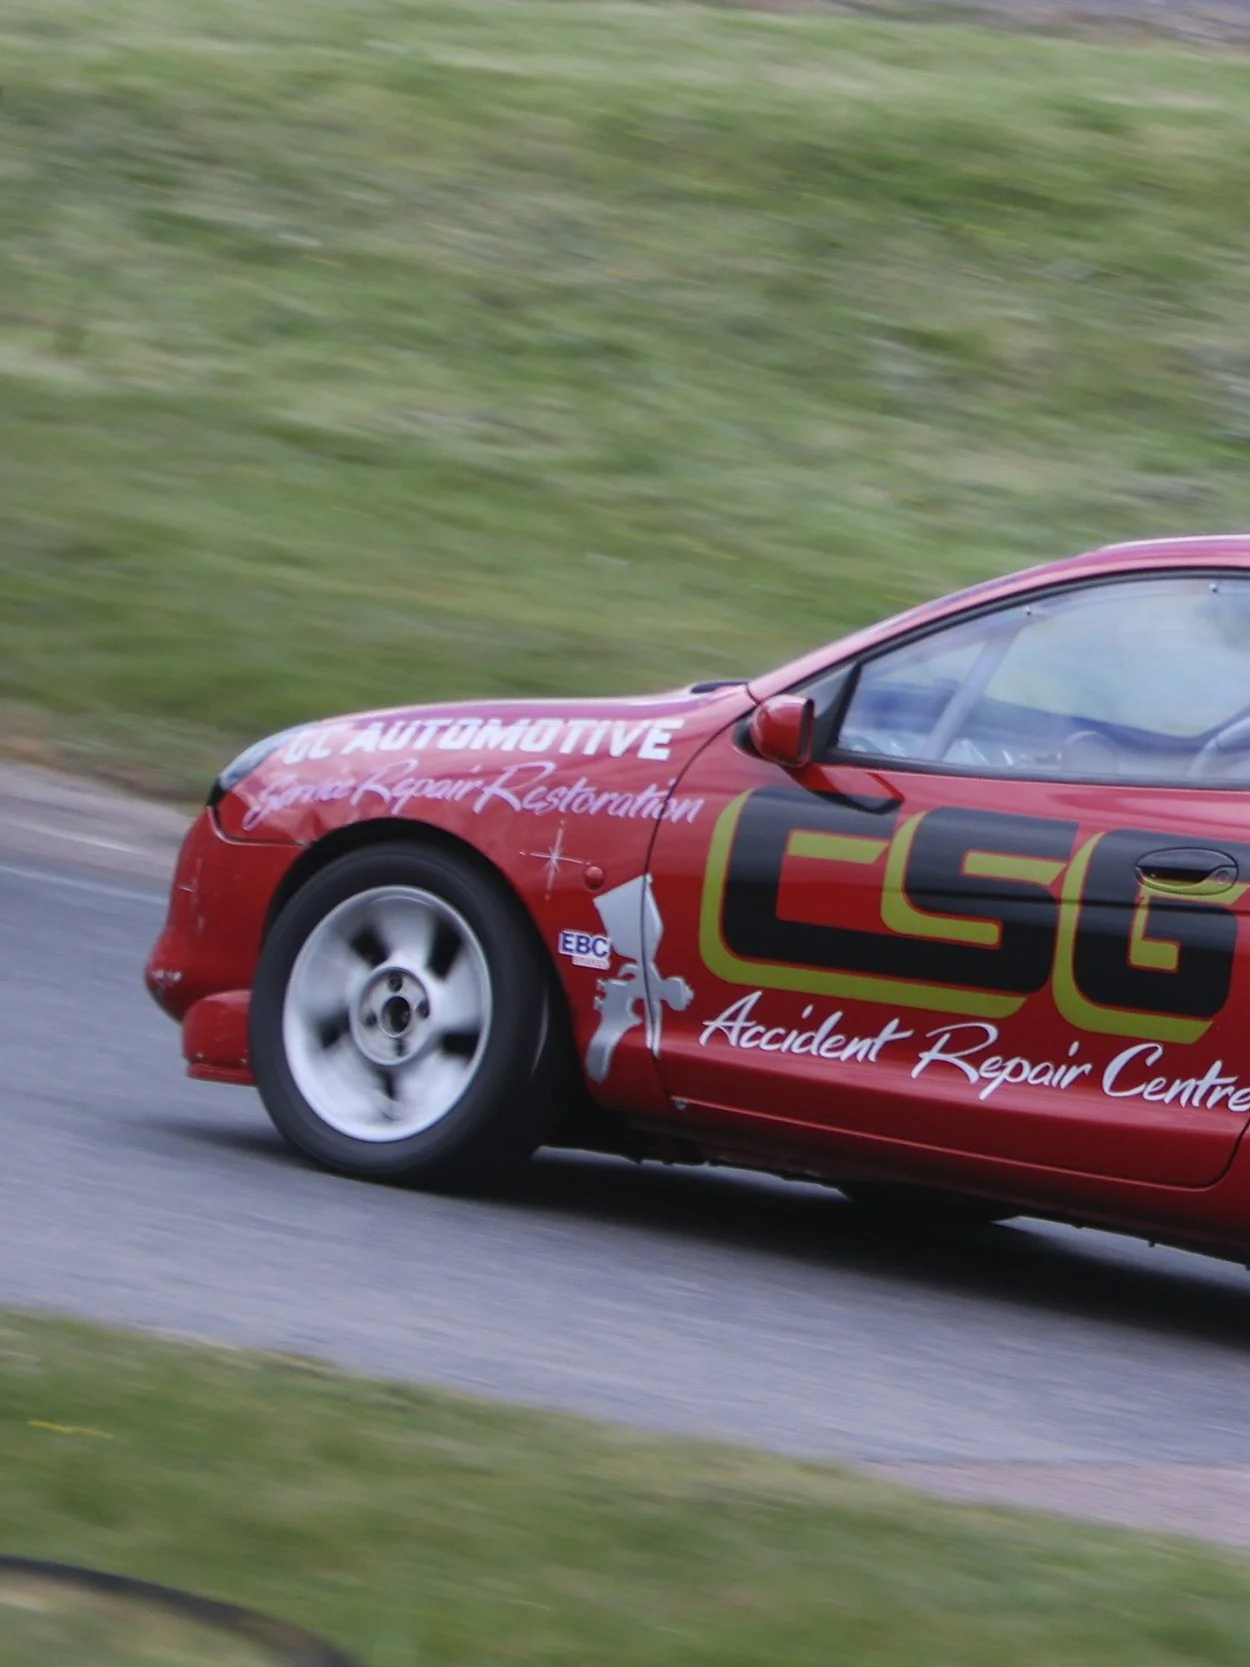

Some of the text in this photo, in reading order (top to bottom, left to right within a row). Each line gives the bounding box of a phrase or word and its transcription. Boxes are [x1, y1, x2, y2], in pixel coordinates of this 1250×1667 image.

[339, 718, 685, 761] AUTOMOTIVE
[351, 758, 484, 816] Repair
[473, 761, 706, 824] Restoration
[561, 932, 608, 958] EBC
[698, 989, 911, 1064] Accident
[910, 1021, 1093, 1100] Repair
